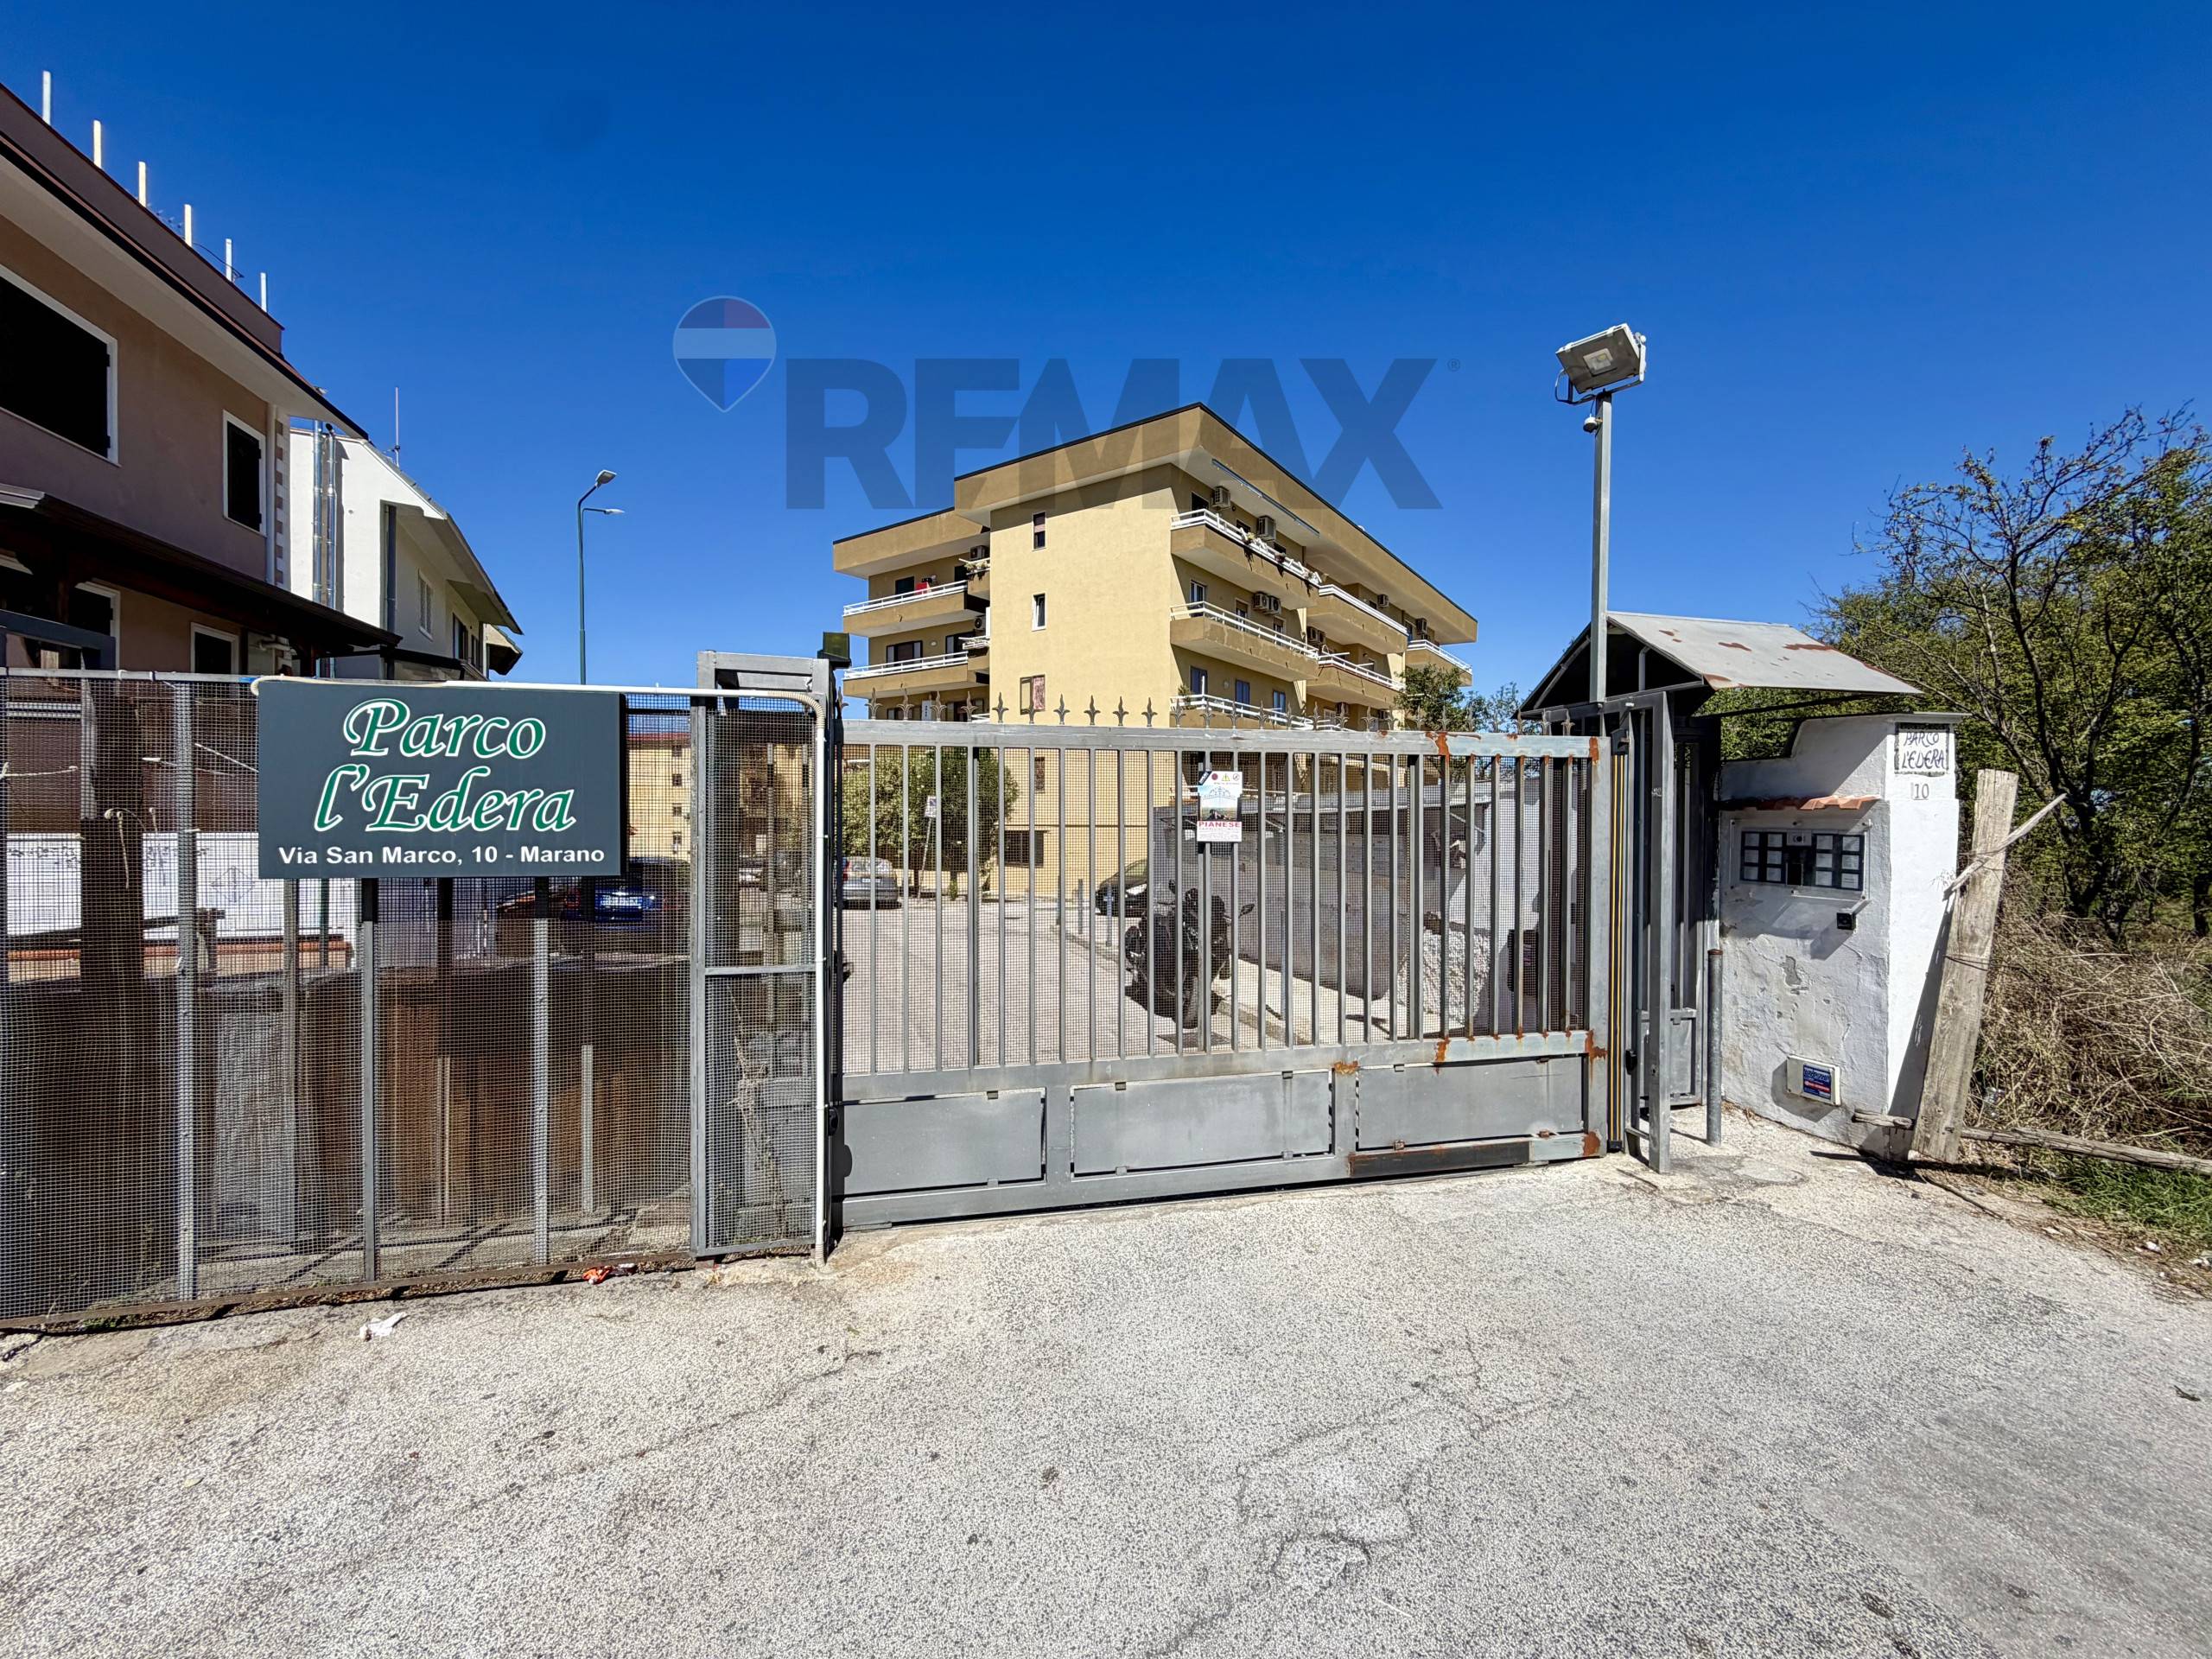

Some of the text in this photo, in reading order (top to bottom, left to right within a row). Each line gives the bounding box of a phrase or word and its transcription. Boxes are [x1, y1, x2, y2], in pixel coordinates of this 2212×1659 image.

[343, 698, 547, 760] Parco
[1904, 732, 1940, 747] PARCO
[1902, 749, 1946, 769] L'EDERA
[314, 764, 576, 832] l'Edera
[1914, 783, 1929, 800] 10
[278, 847, 318, 864] Via
[327, 846, 373, 864] San
[382, 846, 462, 865] Marco,
[471, 846, 498, 862] 10
[520, 846, 605, 862] Marano
